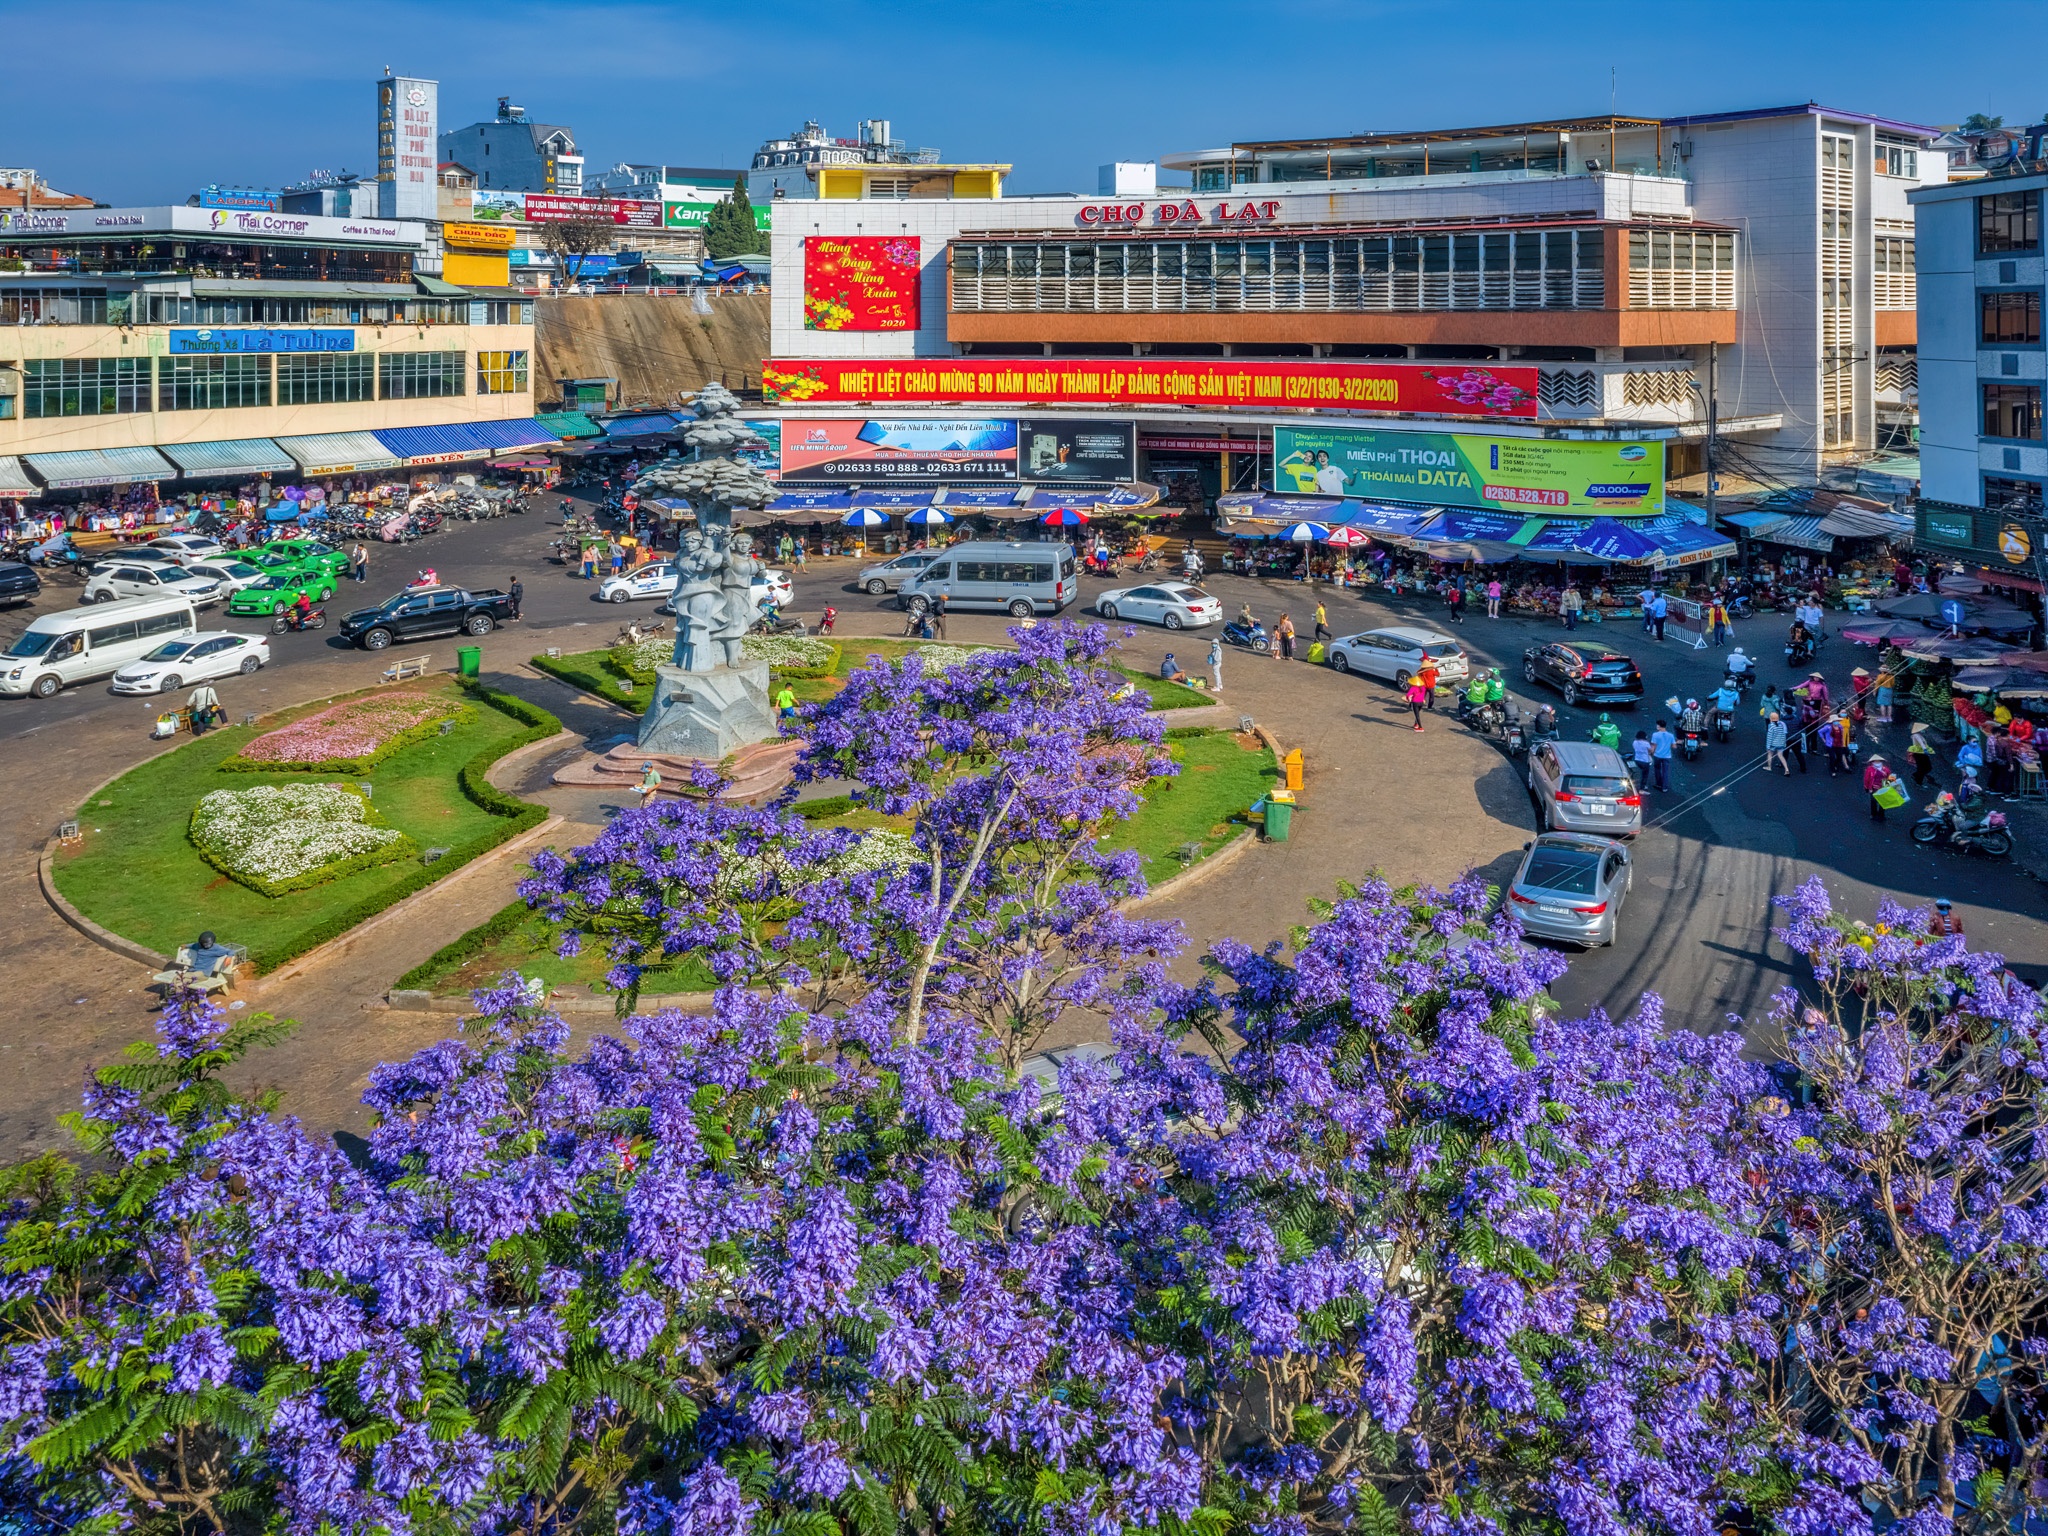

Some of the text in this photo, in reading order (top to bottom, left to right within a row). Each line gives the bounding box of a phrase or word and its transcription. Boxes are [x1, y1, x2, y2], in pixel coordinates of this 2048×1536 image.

[405, 124, 428, 137] THÀNH
[401, 155, 432, 168] FESTIVAL
[410, 171, 424, 182] HOA
[1079, 198, 1282, 227] CHỢ ĐÀ LẠT
[33, 215, 68, 227] Corner
[96, 217, 112, 226] Coffee
[234, 213, 309, 231] Thai Corner
[343, 225, 396, 236] Coffee & Thai Food
[863, 287, 897, 299] Xuân
[880, 319, 906, 327] 2020
[180, 339, 220, 352] Thương
[242, 331, 351, 352] La Tulipe
[839, 367, 1399, 404] NHIỆT LIỆT CHÀO MỪNG 90 NĂM NGÀY THÀNH LẬP ĐẢNG CỘNG SẢN VIỆT NAM (3/2/1930-3/2/2020)
[1320, 434, 1334, 442] sang
[1230, 442, 1247, 450] TRONG
[412, 456, 436, 465] KIM
[441, 452, 465, 463] YẾN
[1347, 448, 1456, 468] MIỄN PHÍ THOẠI
[838, 464, 1007, 472] 02633 580 888 02633 671 111
[1418, 469, 1472, 489] DATA
[1485, 486, 1565, 505] 02636.528.718
[1679, 553, 1697, 564] MINH
[1698, 550, 1713, 561] TÂM
